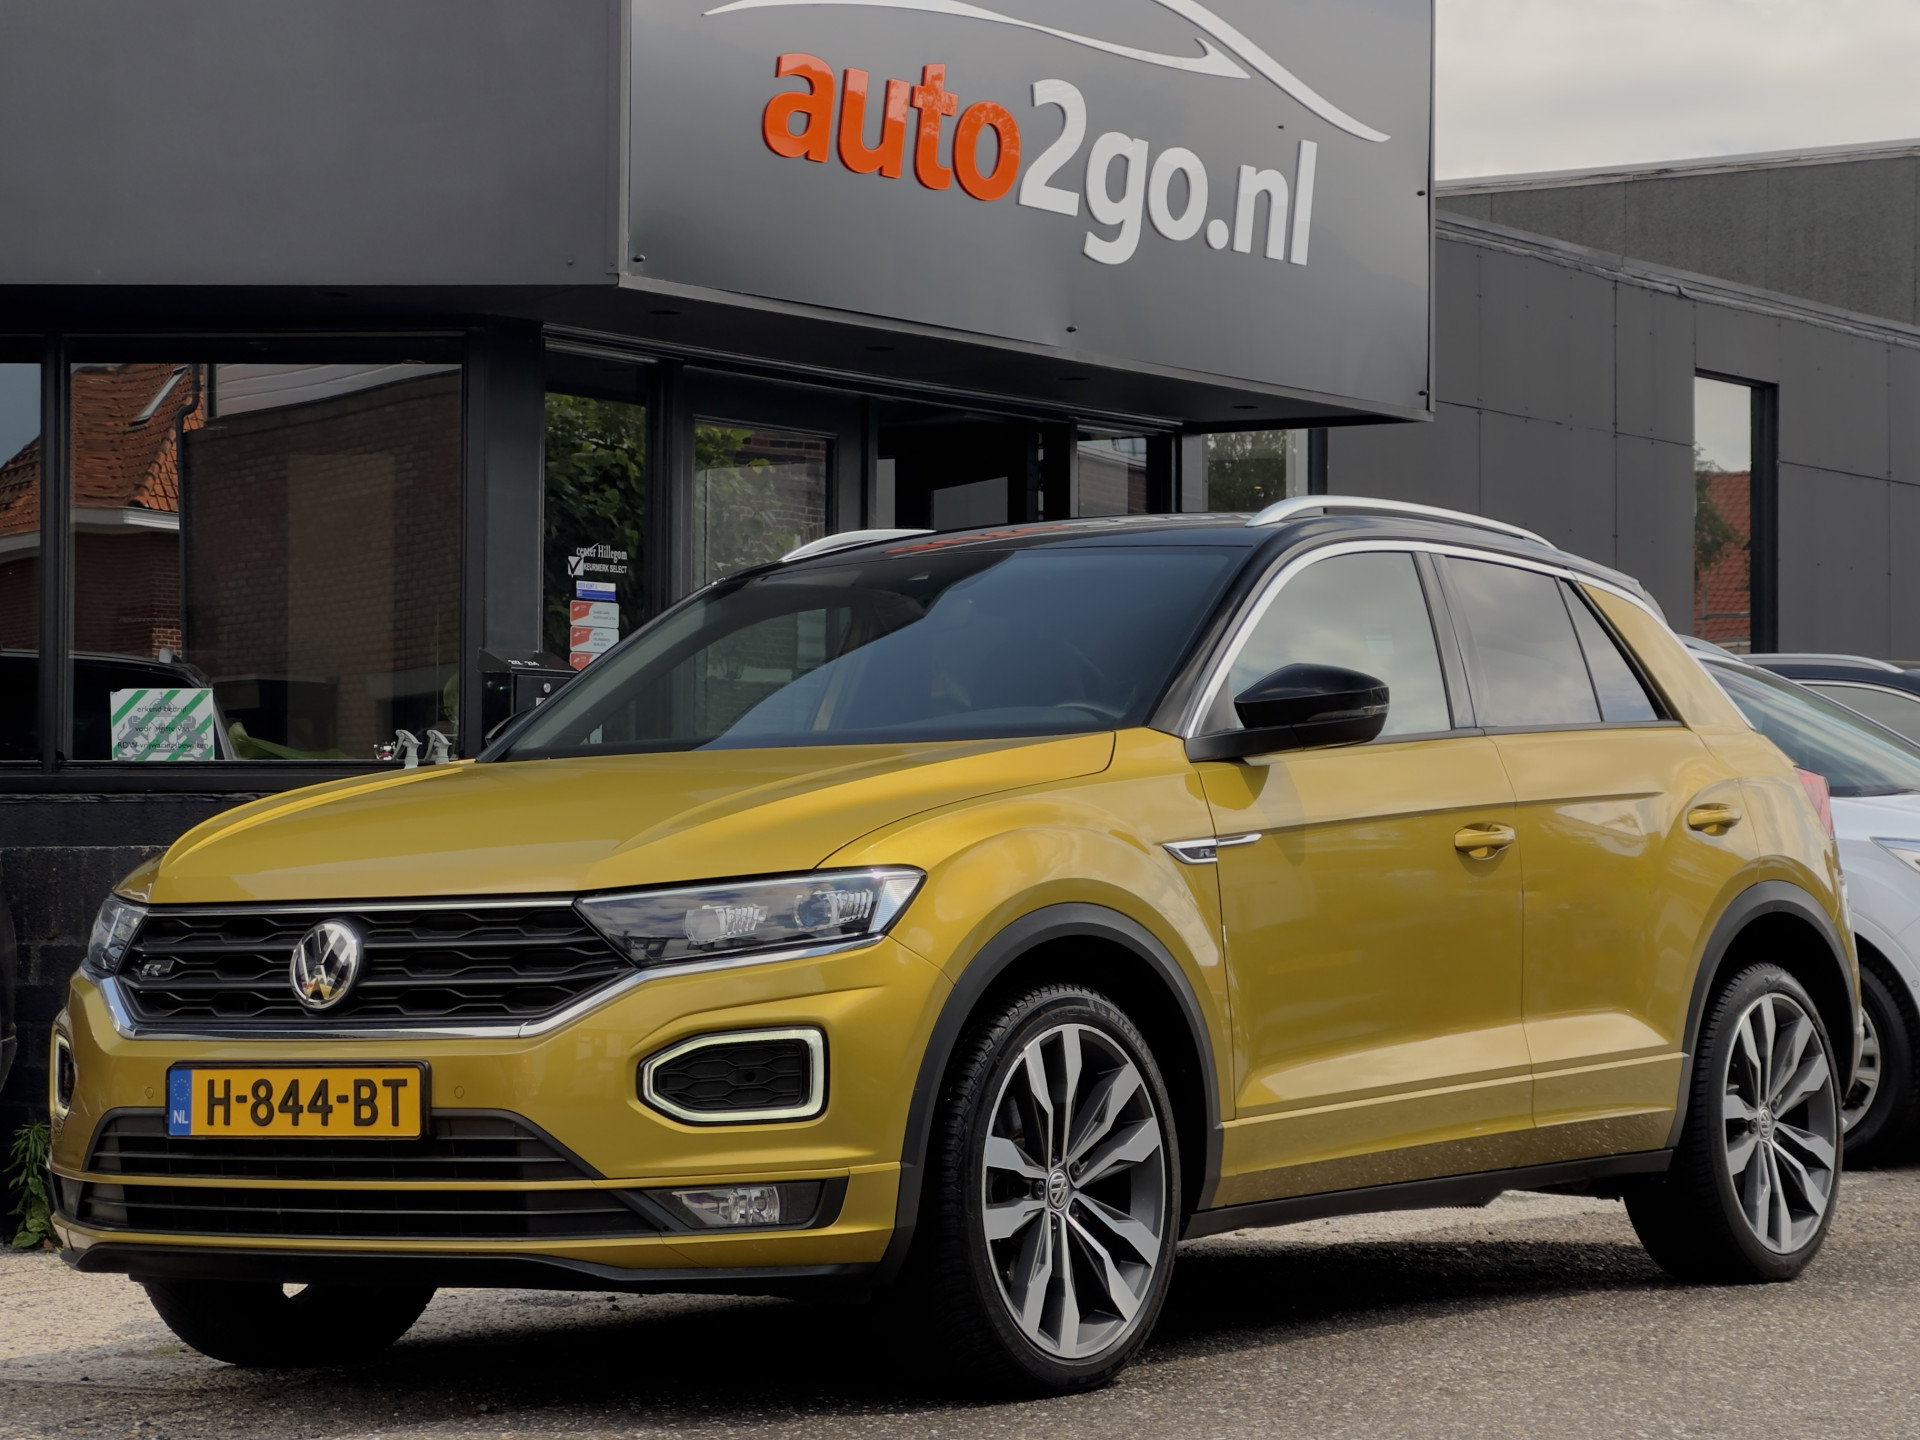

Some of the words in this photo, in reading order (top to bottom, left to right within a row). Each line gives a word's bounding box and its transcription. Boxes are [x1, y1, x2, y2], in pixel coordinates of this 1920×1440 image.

[762, 52, 1318, 266] auto2go.nl
[598, 544, 628, 563] Hillegom
[609, 564, 628, 574] SELECT
[137, 705, 162, 713] erkend
[207, 1078, 408, 1127] H-844-BT
[173, 1110, 189, 1125] NL
